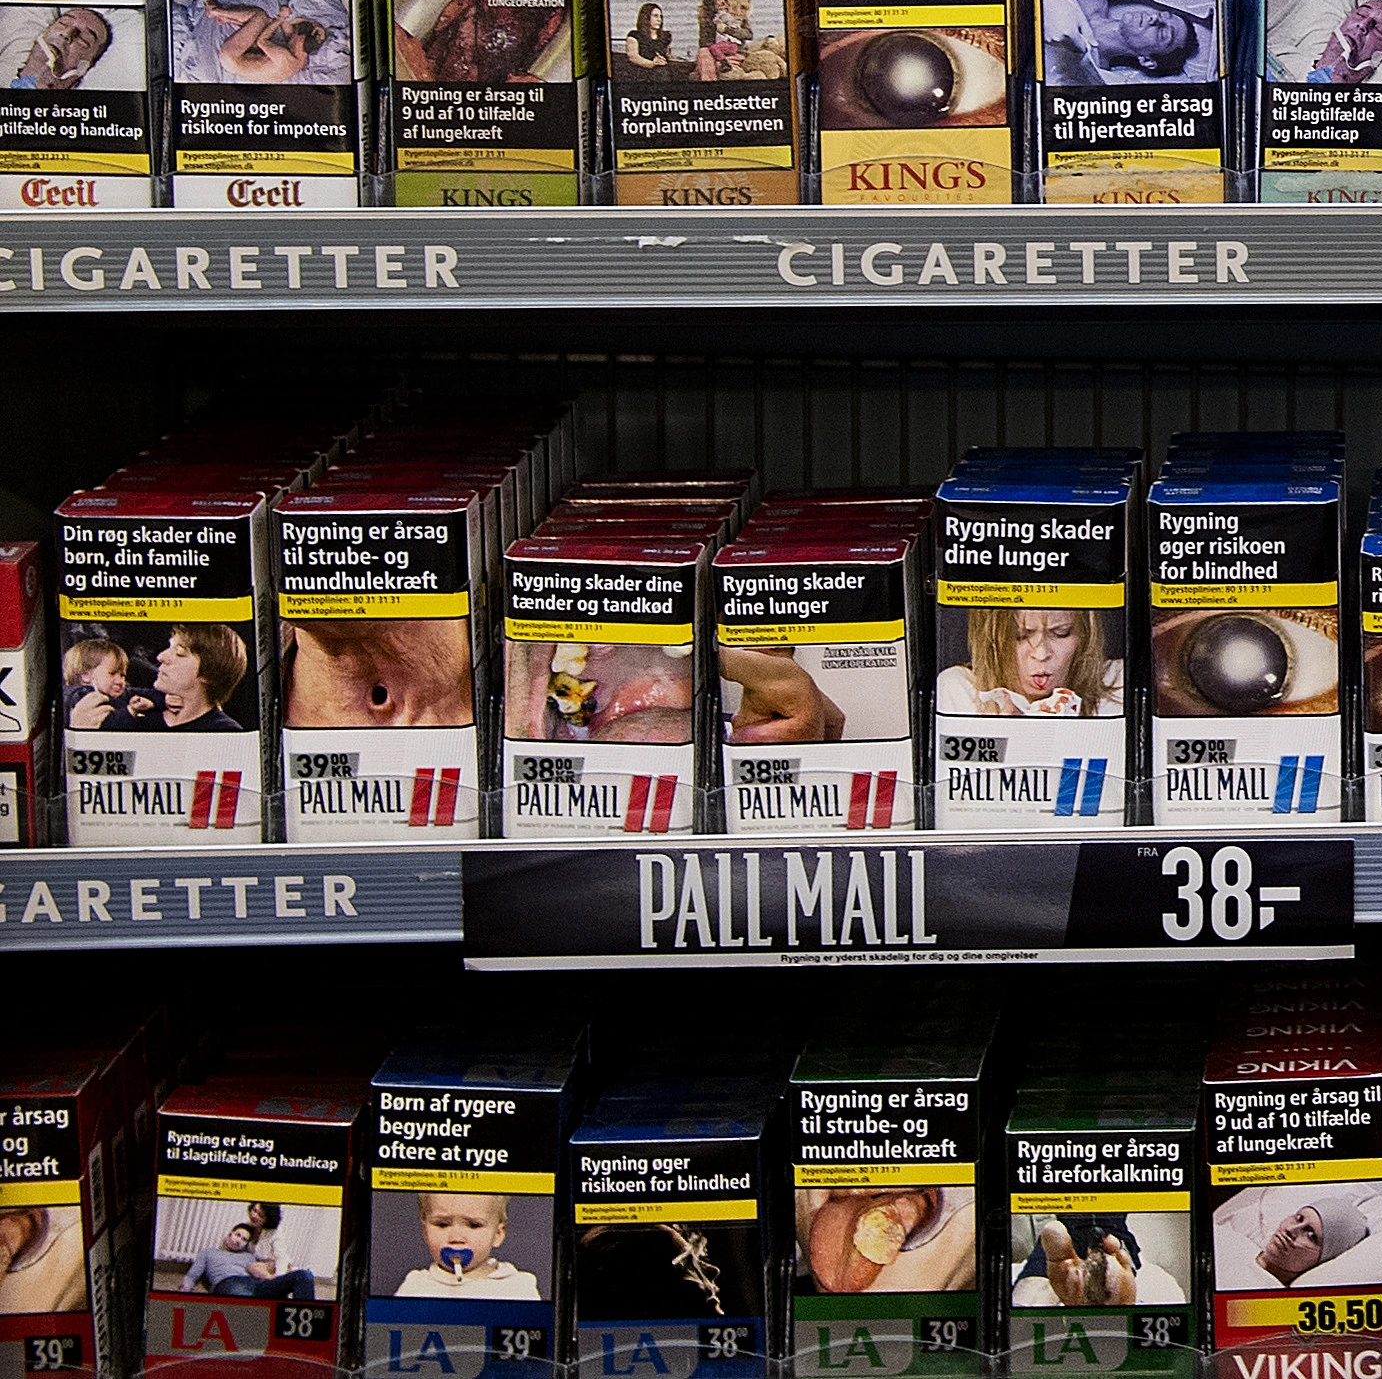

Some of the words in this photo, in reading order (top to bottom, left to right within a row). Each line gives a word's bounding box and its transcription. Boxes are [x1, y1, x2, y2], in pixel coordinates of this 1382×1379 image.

[488, 0, 564, 7] LUNGEOPERATION
[64, 526, 93, 541] Din
[98, 530, 127, 546] røg
[133, 526, 192, 543] skader
[197, 527, 236, 544] dine
[64, 547, 109, 567] børn,
[115, 549, 143, 565] din
[147, 549, 209, 566] familie
[65, 574, 86, 591] og
[91, 571, 130, 588] dine
[135, 576, 197, 588] venner
[79, 779, 127, 816] PALL
[132, 779, 186, 816] MALL
[1137, 848, 1158, 856] FRA
[638, 850, 772, 947] PALL
[788, 850, 937, 944] MALL
[801, 1090, 882, 1113] Rygning
[888, 1094, 909, 1108] er
[914, 1088, 968, 1111] årsag
[801, 1115, 820, 1133] til
[827, 1115, 898, 1134] strube-
[903, 1119, 928, 1137] og
[802, 1139, 956, 1159] mundhulekræft
